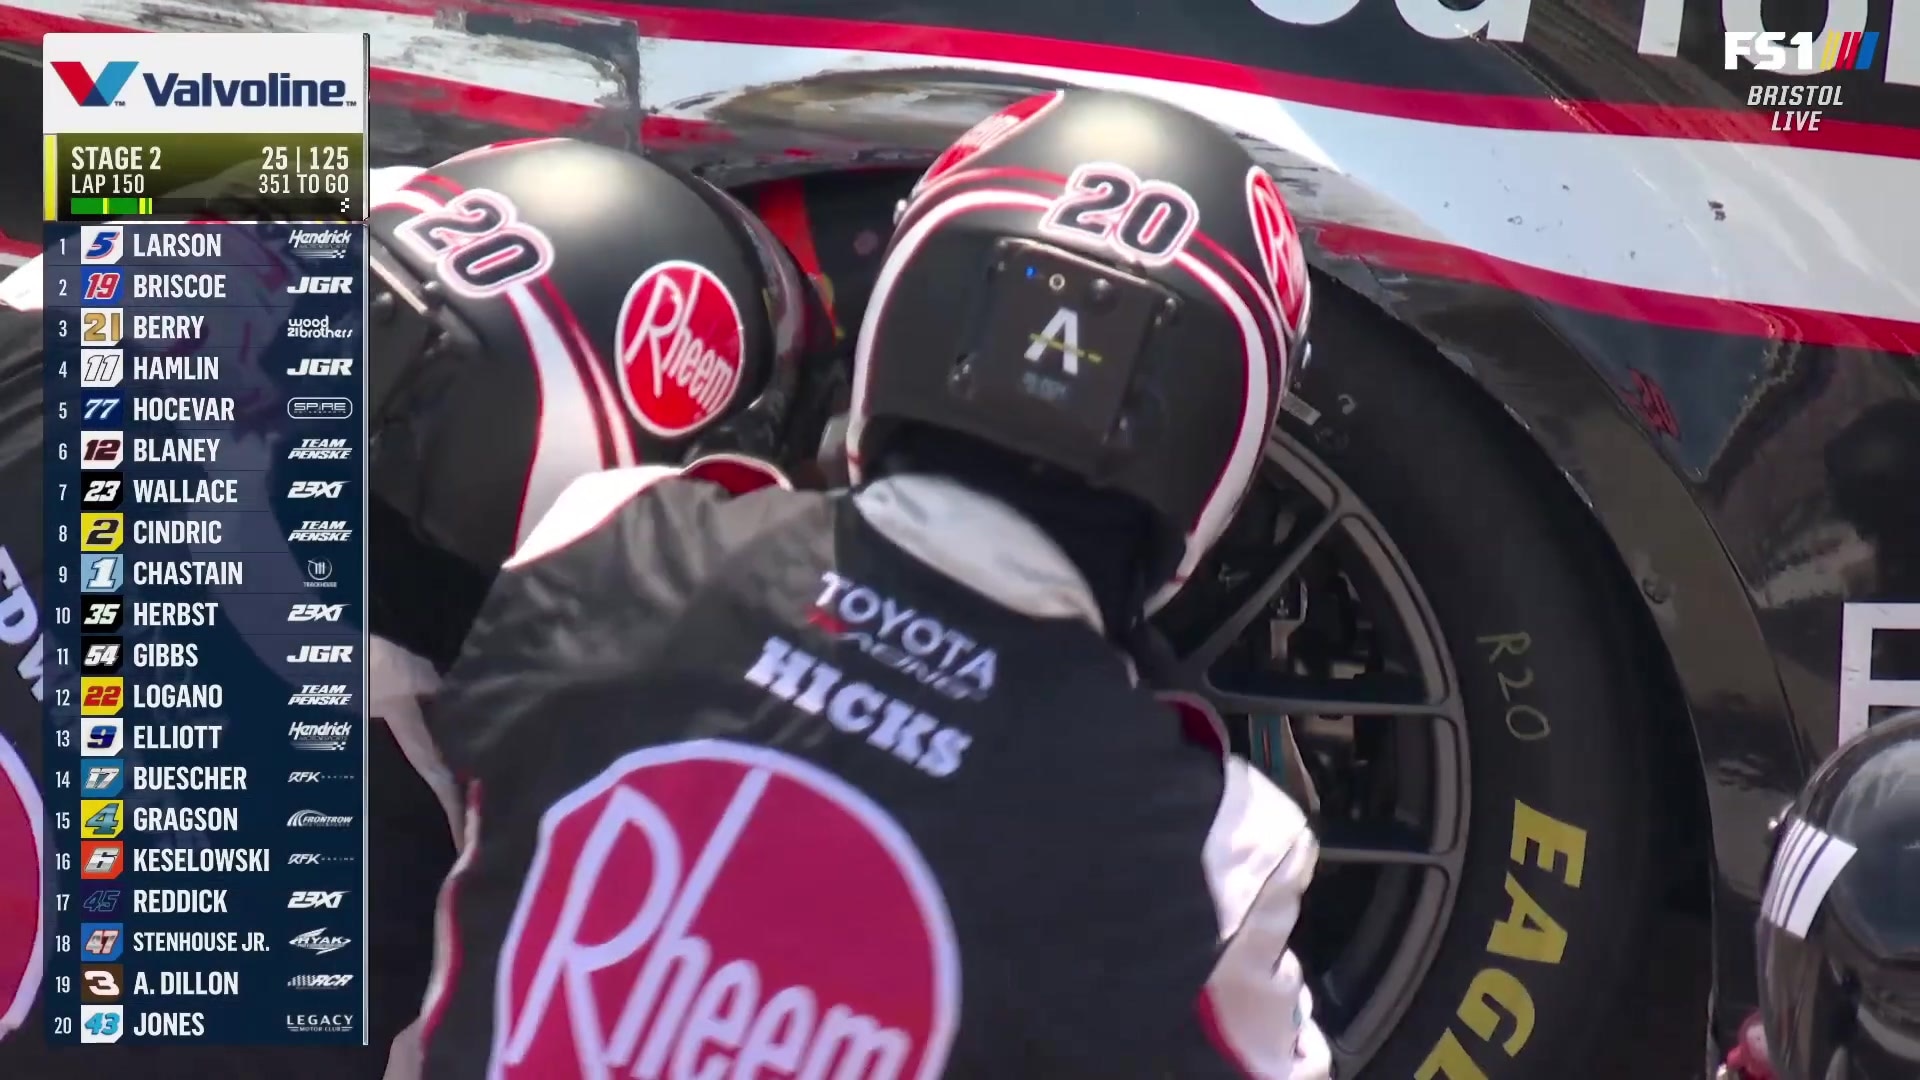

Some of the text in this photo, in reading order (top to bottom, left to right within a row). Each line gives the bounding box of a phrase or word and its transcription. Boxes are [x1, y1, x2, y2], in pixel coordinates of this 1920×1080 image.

[394, 188, 555, 298] 20
[1038, 162, 1200, 266] 20
[625, 270, 733, 412] Rheem
[815, 571, 997, 690] TOYOTA
[1476, 631, 1551, 741] R20
[744, 636, 974, 777] HICKS
[502, 766, 913, 1080] Rheem
